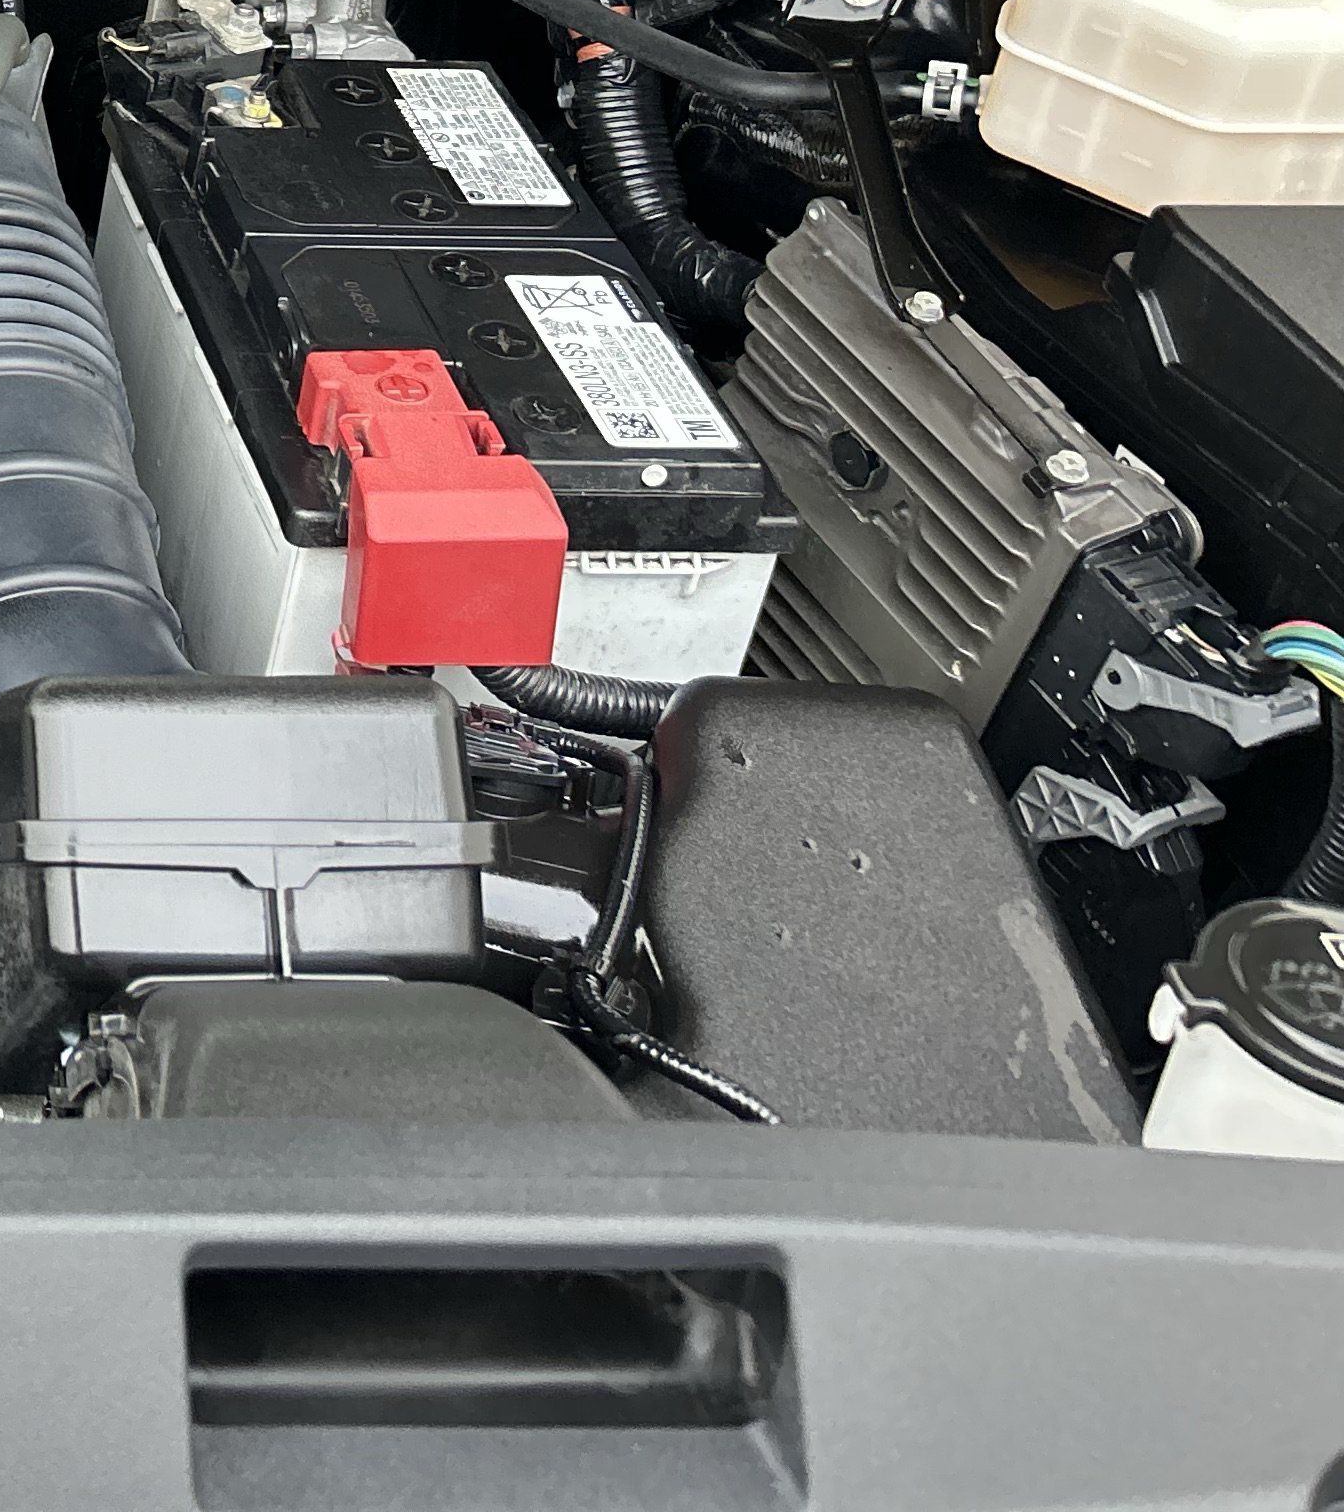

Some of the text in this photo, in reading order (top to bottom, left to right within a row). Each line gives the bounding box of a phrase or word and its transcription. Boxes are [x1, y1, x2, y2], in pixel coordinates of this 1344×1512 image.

[594, 291, 612, 304] Pb
[554, 342, 620, 407] 380LN3-ISS
[682, 420, 721, 440] TM
